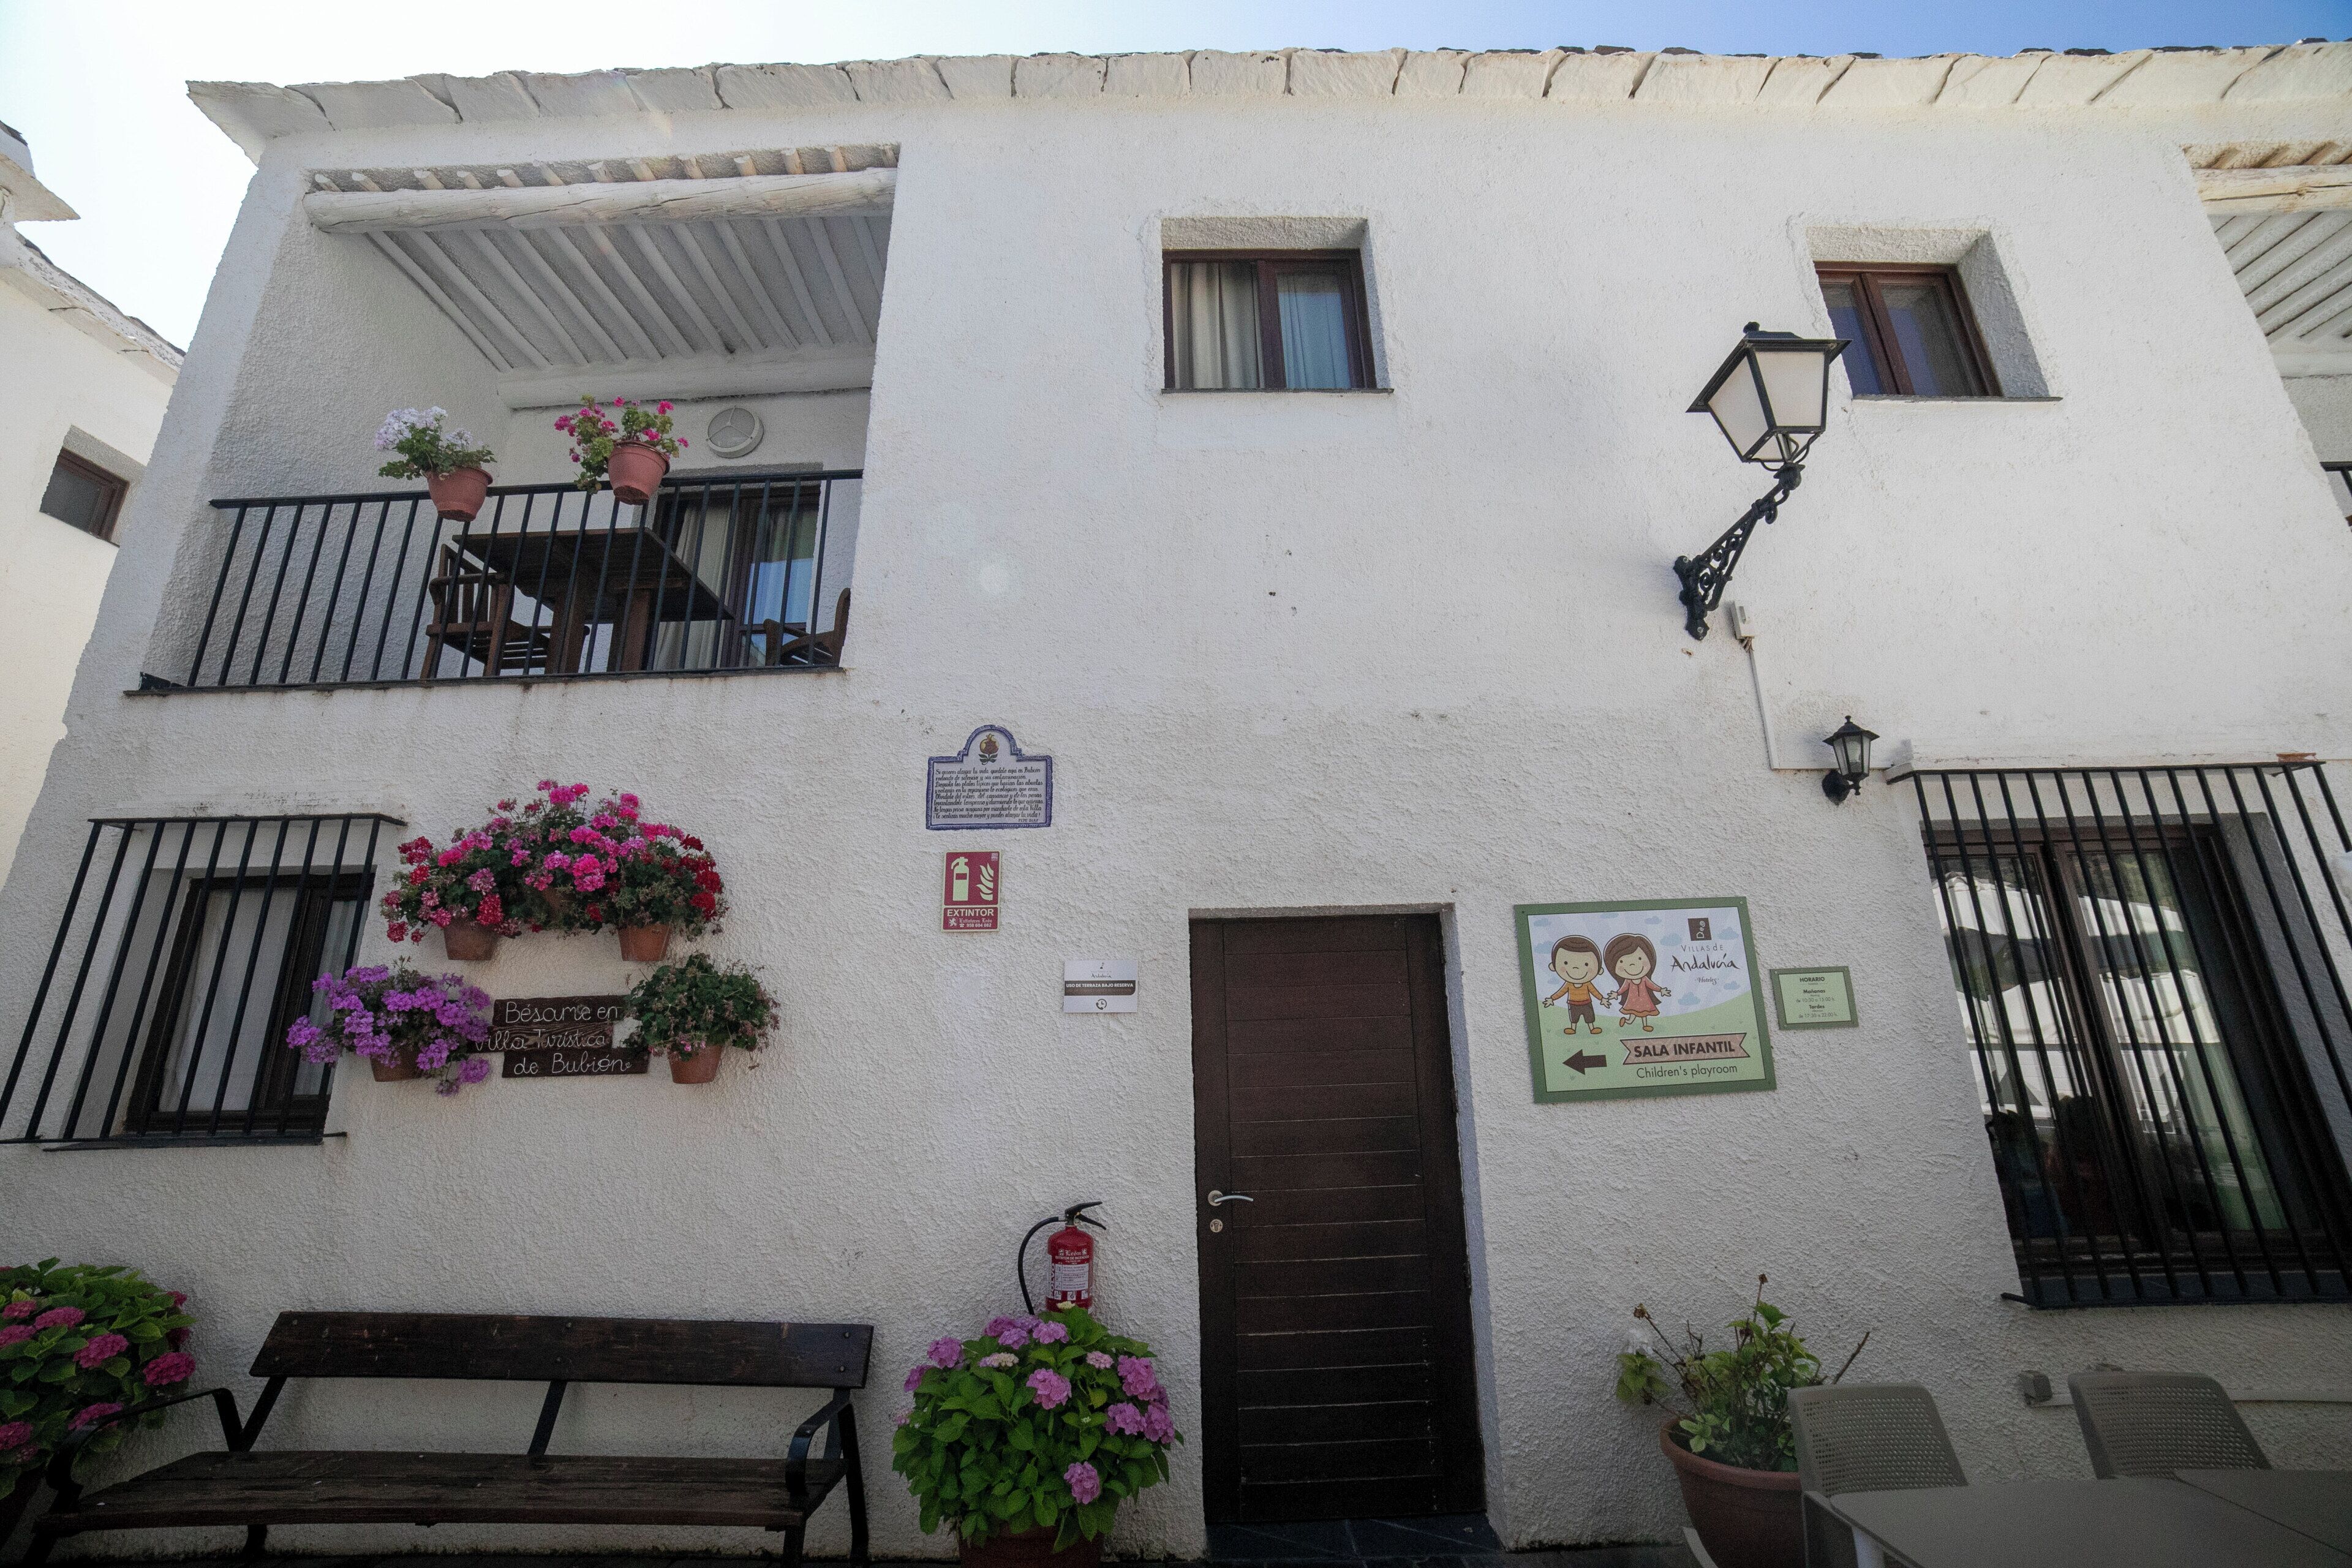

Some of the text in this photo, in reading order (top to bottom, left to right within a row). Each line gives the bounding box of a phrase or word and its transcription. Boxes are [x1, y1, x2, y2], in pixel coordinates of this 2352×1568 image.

[947, 908, 994, 917] EXTINTOR
[1670, 953, 1740, 973] Andalucía
[505, 1001, 618, 1023] Bésame en
[533, 1029, 605, 1049] Turística
[1634, 1041, 1735, 1058] SALA INFANTIL
[514, 1050, 628, 1075] de Bubión
[1637, 1064, 1738, 1079] Children's playroom
